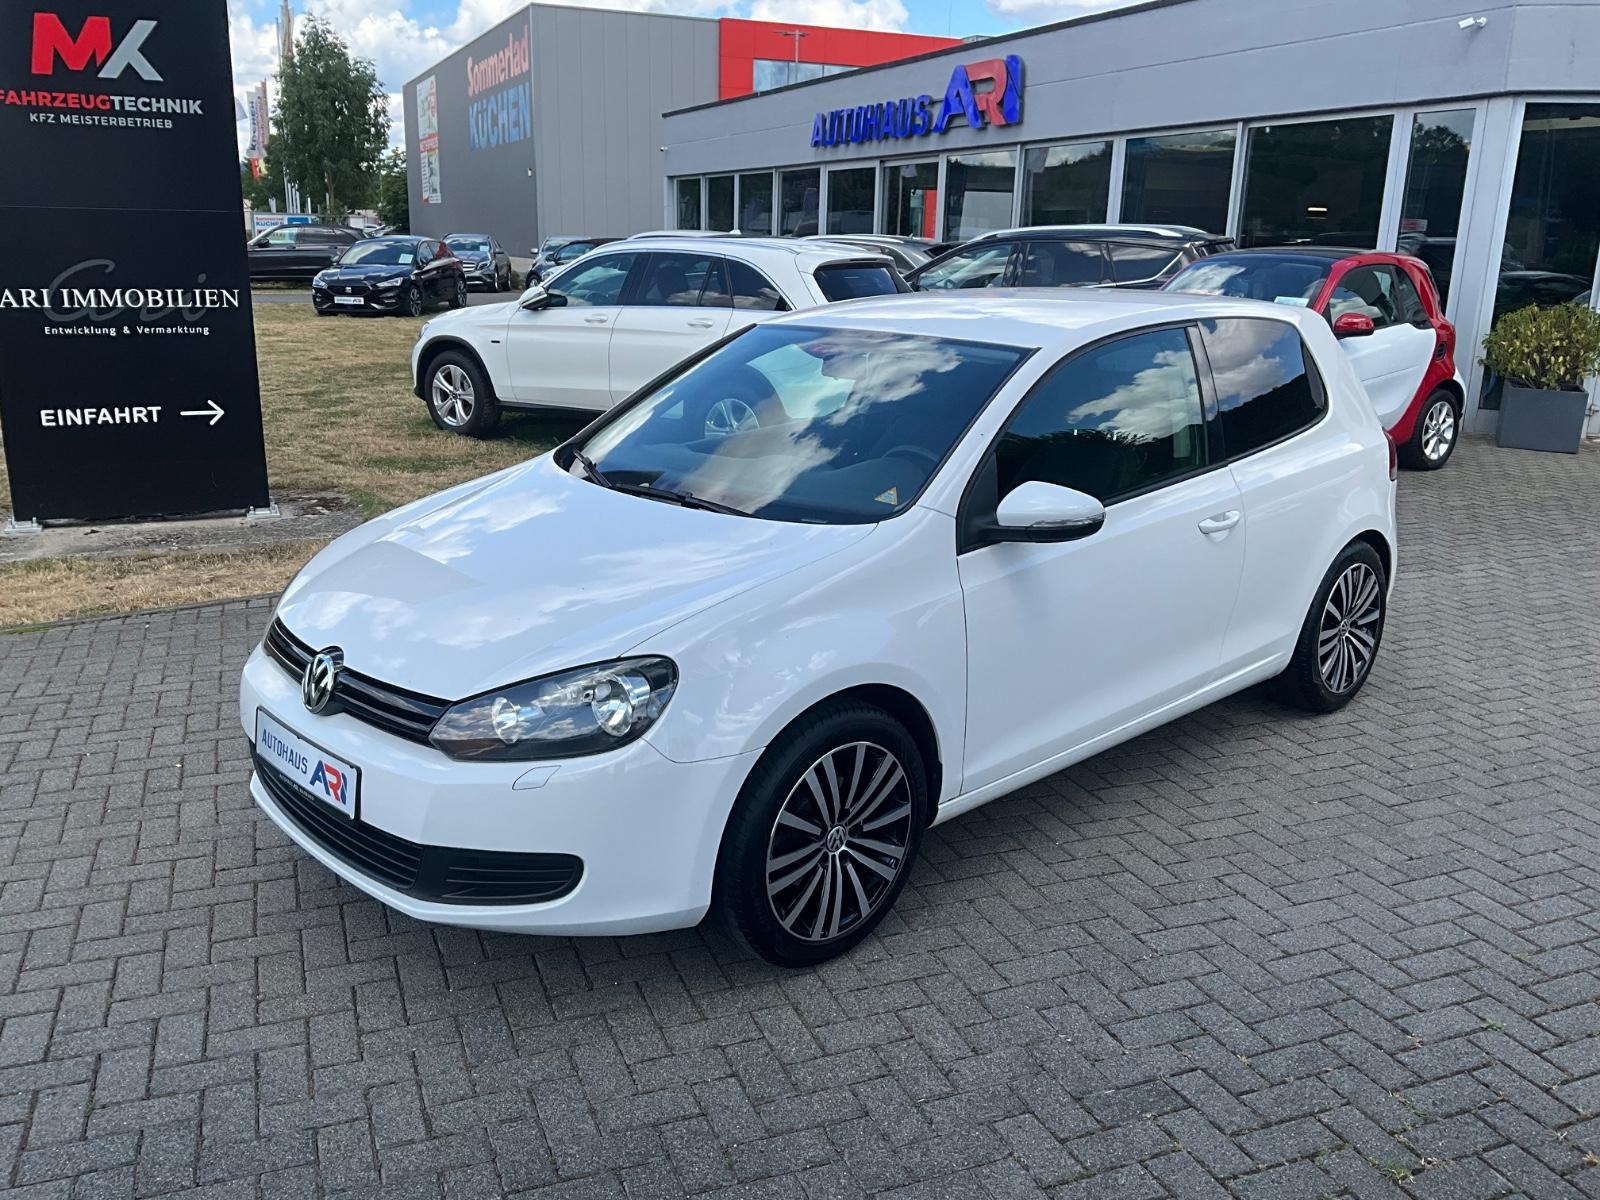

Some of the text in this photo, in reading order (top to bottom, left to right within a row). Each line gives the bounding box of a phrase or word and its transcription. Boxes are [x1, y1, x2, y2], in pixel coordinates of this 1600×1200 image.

[31, 12, 164, 81] MK
[467, 24, 529, 97] Sommerlad
[29, 112, 173, 129] KFZ MEISTERBETRIEB
[468, 82, 532, 149] KÜCHEN
[810, 54, 1023, 148] AUTOHAUS ARI
[0, 288, 240, 308] ARI IMMOBILIEN
[44, 325, 210, 337] Entwicklung & Vermarktung
[40, 406, 162, 427] EINFAHRT
[262, 729, 308, 775] AUTOHAUS
[309, 759, 348, 805] ARI
